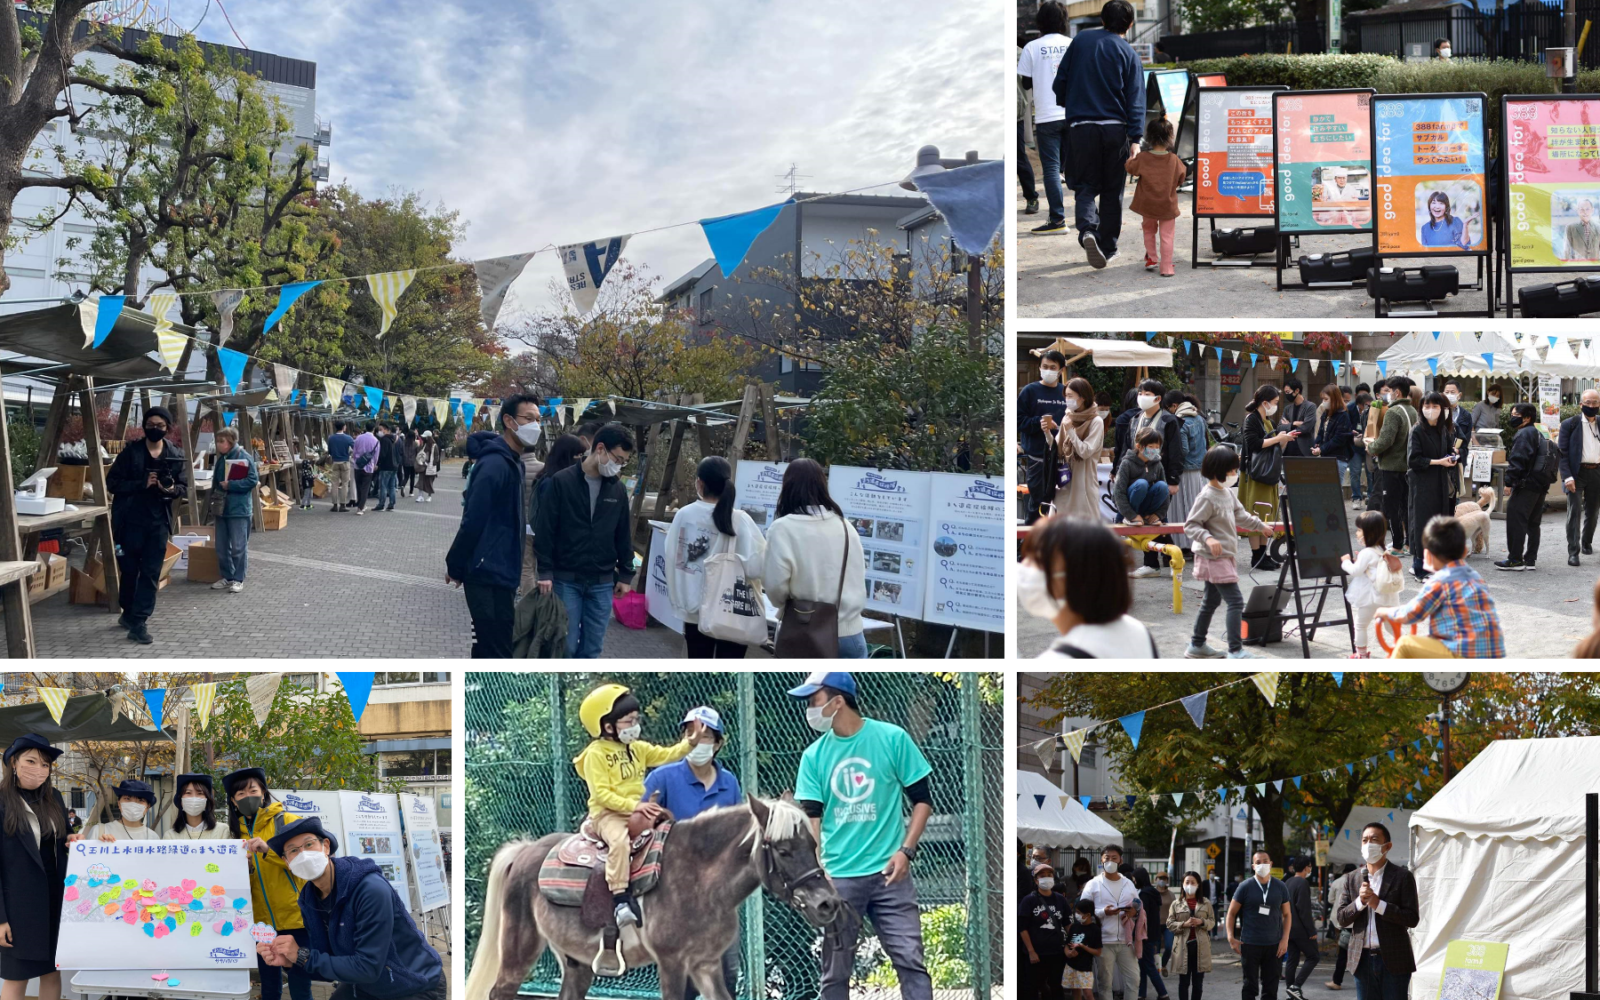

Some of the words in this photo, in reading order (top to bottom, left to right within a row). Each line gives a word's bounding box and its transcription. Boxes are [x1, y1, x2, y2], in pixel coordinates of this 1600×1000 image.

[1200, 109, 1211, 124] for
[1378, 103, 1404, 117] 388
[1510, 105, 1537, 119] 388
[1279, 115, 1291, 133] for
[1377, 122, 1392, 141] for
[1510, 125, 1523, 145] for
[1198, 129, 1211, 153] idea
[1278, 137, 1291, 165] idea
[1197, 158, 1212, 187] good
[1376, 147, 1392, 178] idea
[1508, 153, 1525, 185] idea
[1278, 170, 1295, 201] good
[1376, 184, 1396, 220] good
[1509, 192, 1529, 231] good
[736, 589, 746, 599] THE
